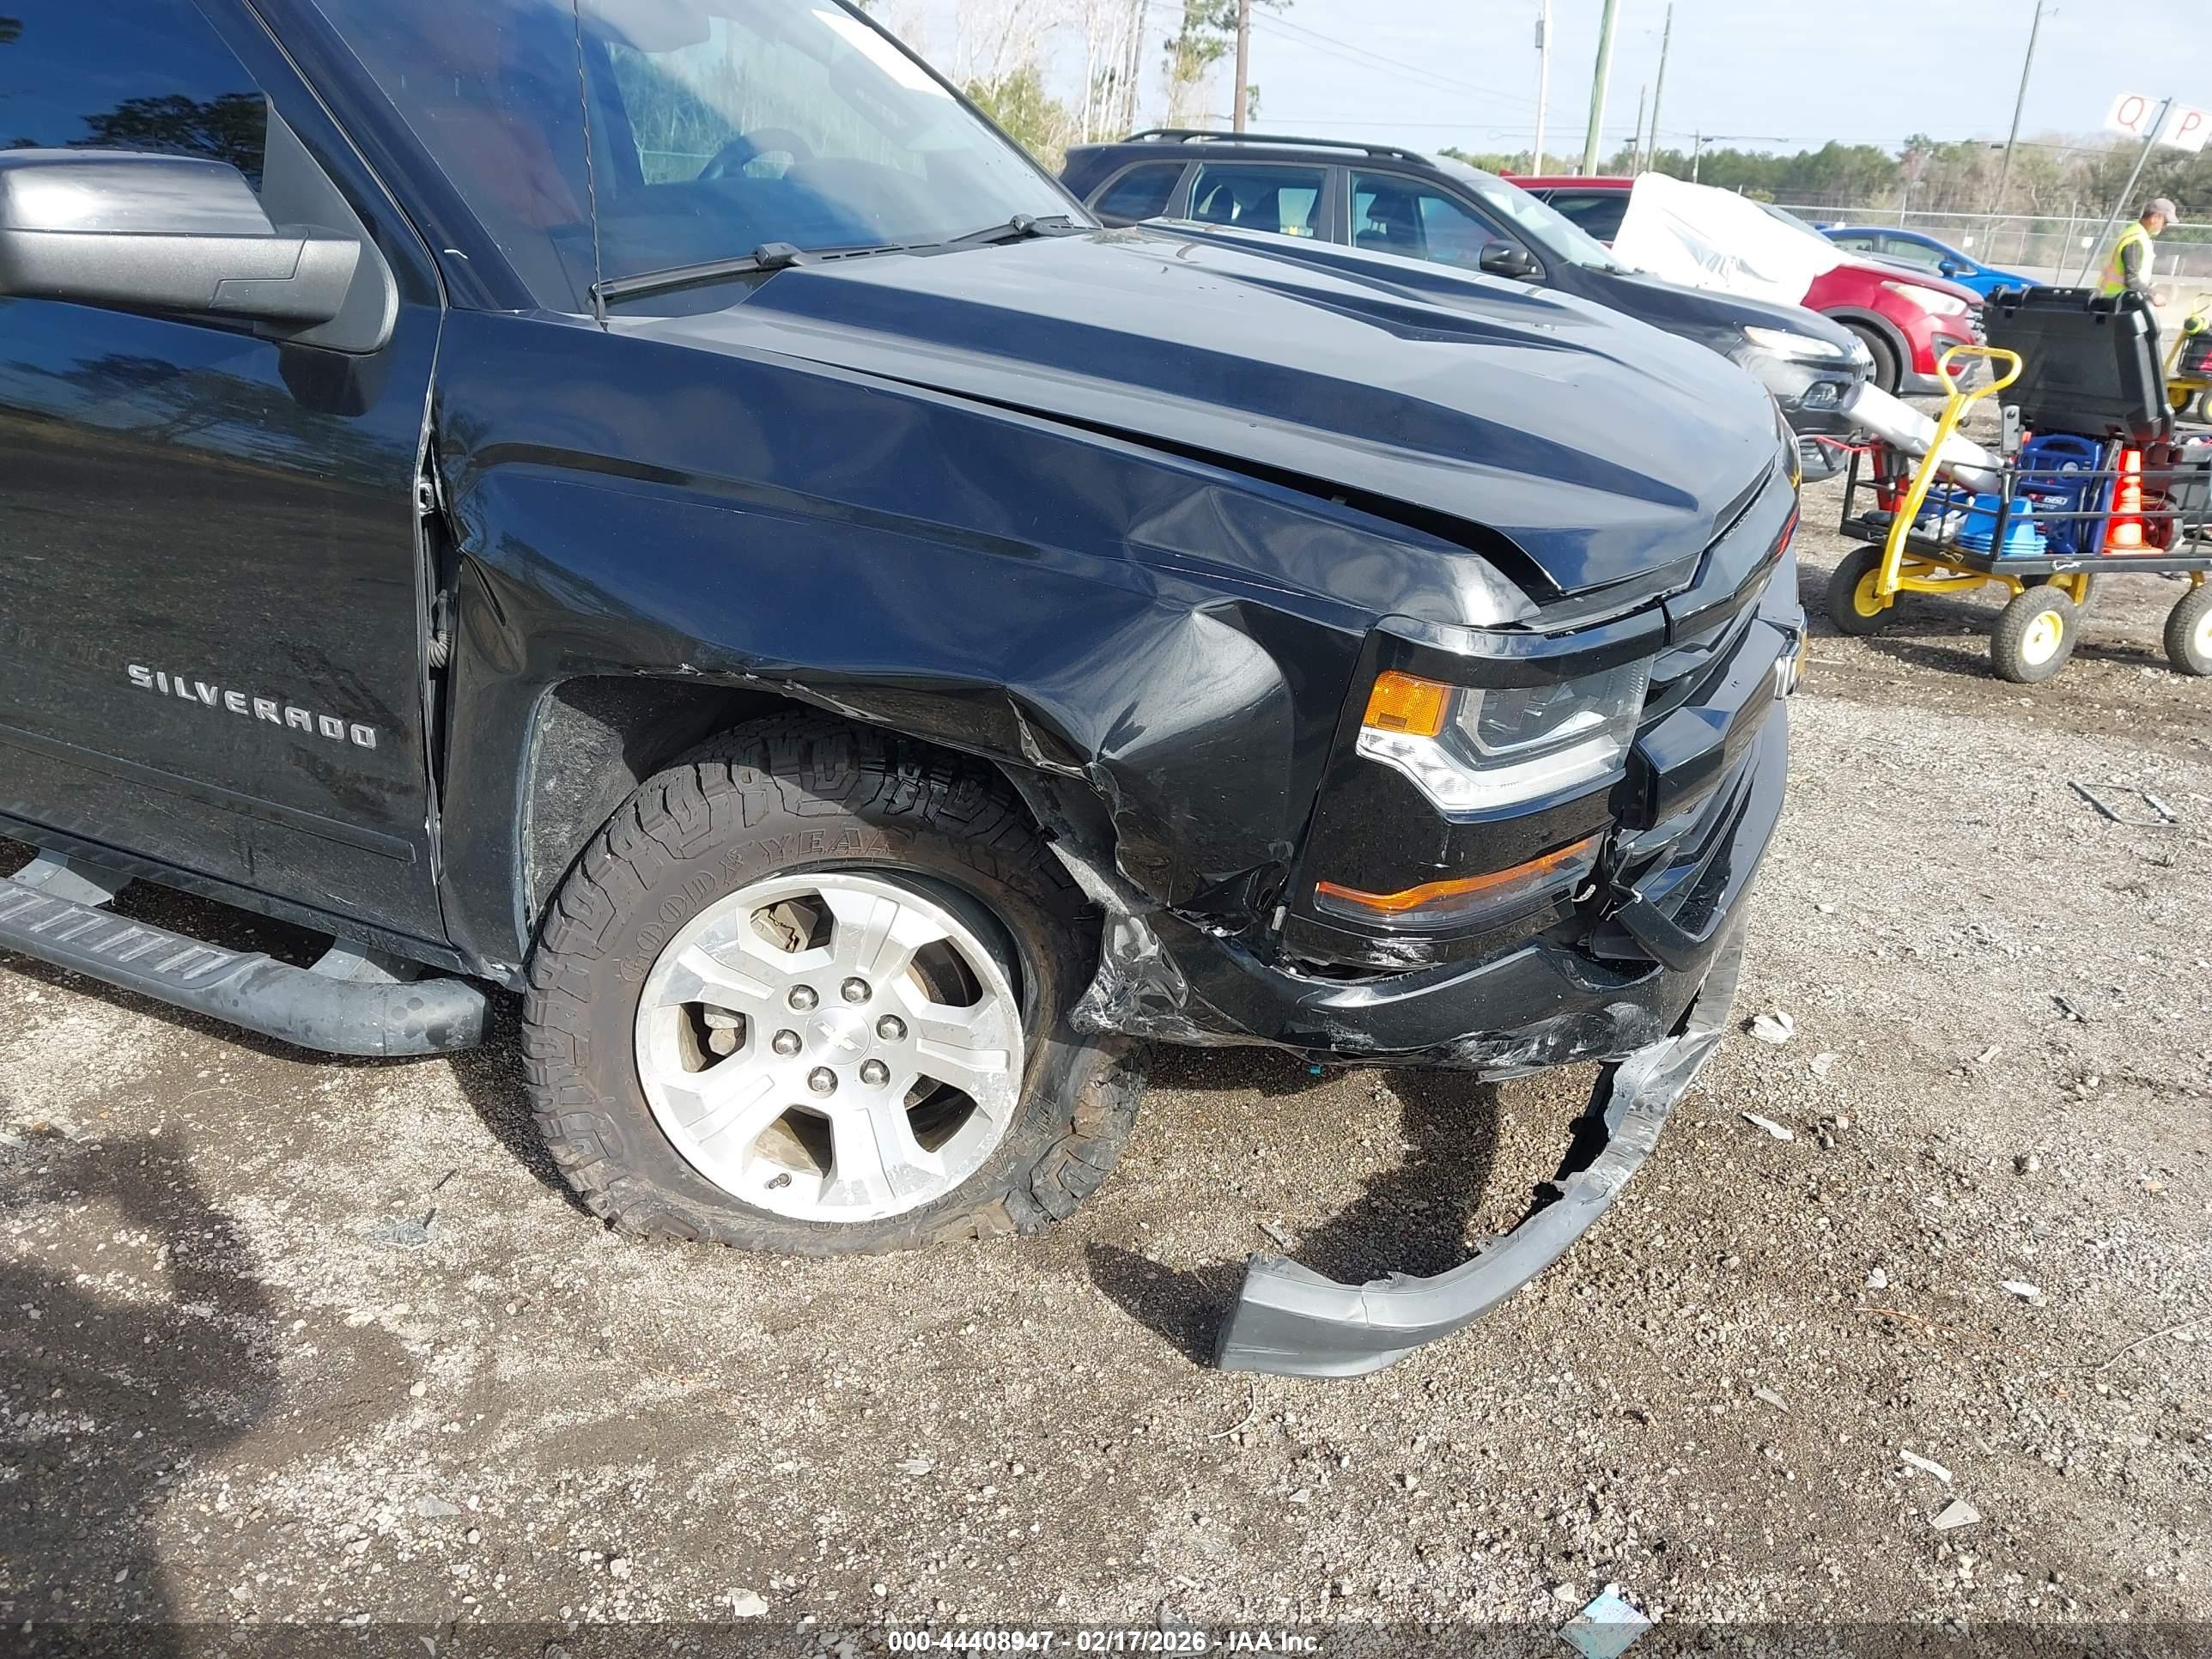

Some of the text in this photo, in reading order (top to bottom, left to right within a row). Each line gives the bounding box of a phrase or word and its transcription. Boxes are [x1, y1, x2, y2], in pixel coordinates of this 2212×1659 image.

[2117, 96, 2145, 131] Q
[2175, 112, 2203, 140] P
[127, 664, 378, 750] SILVERADO
